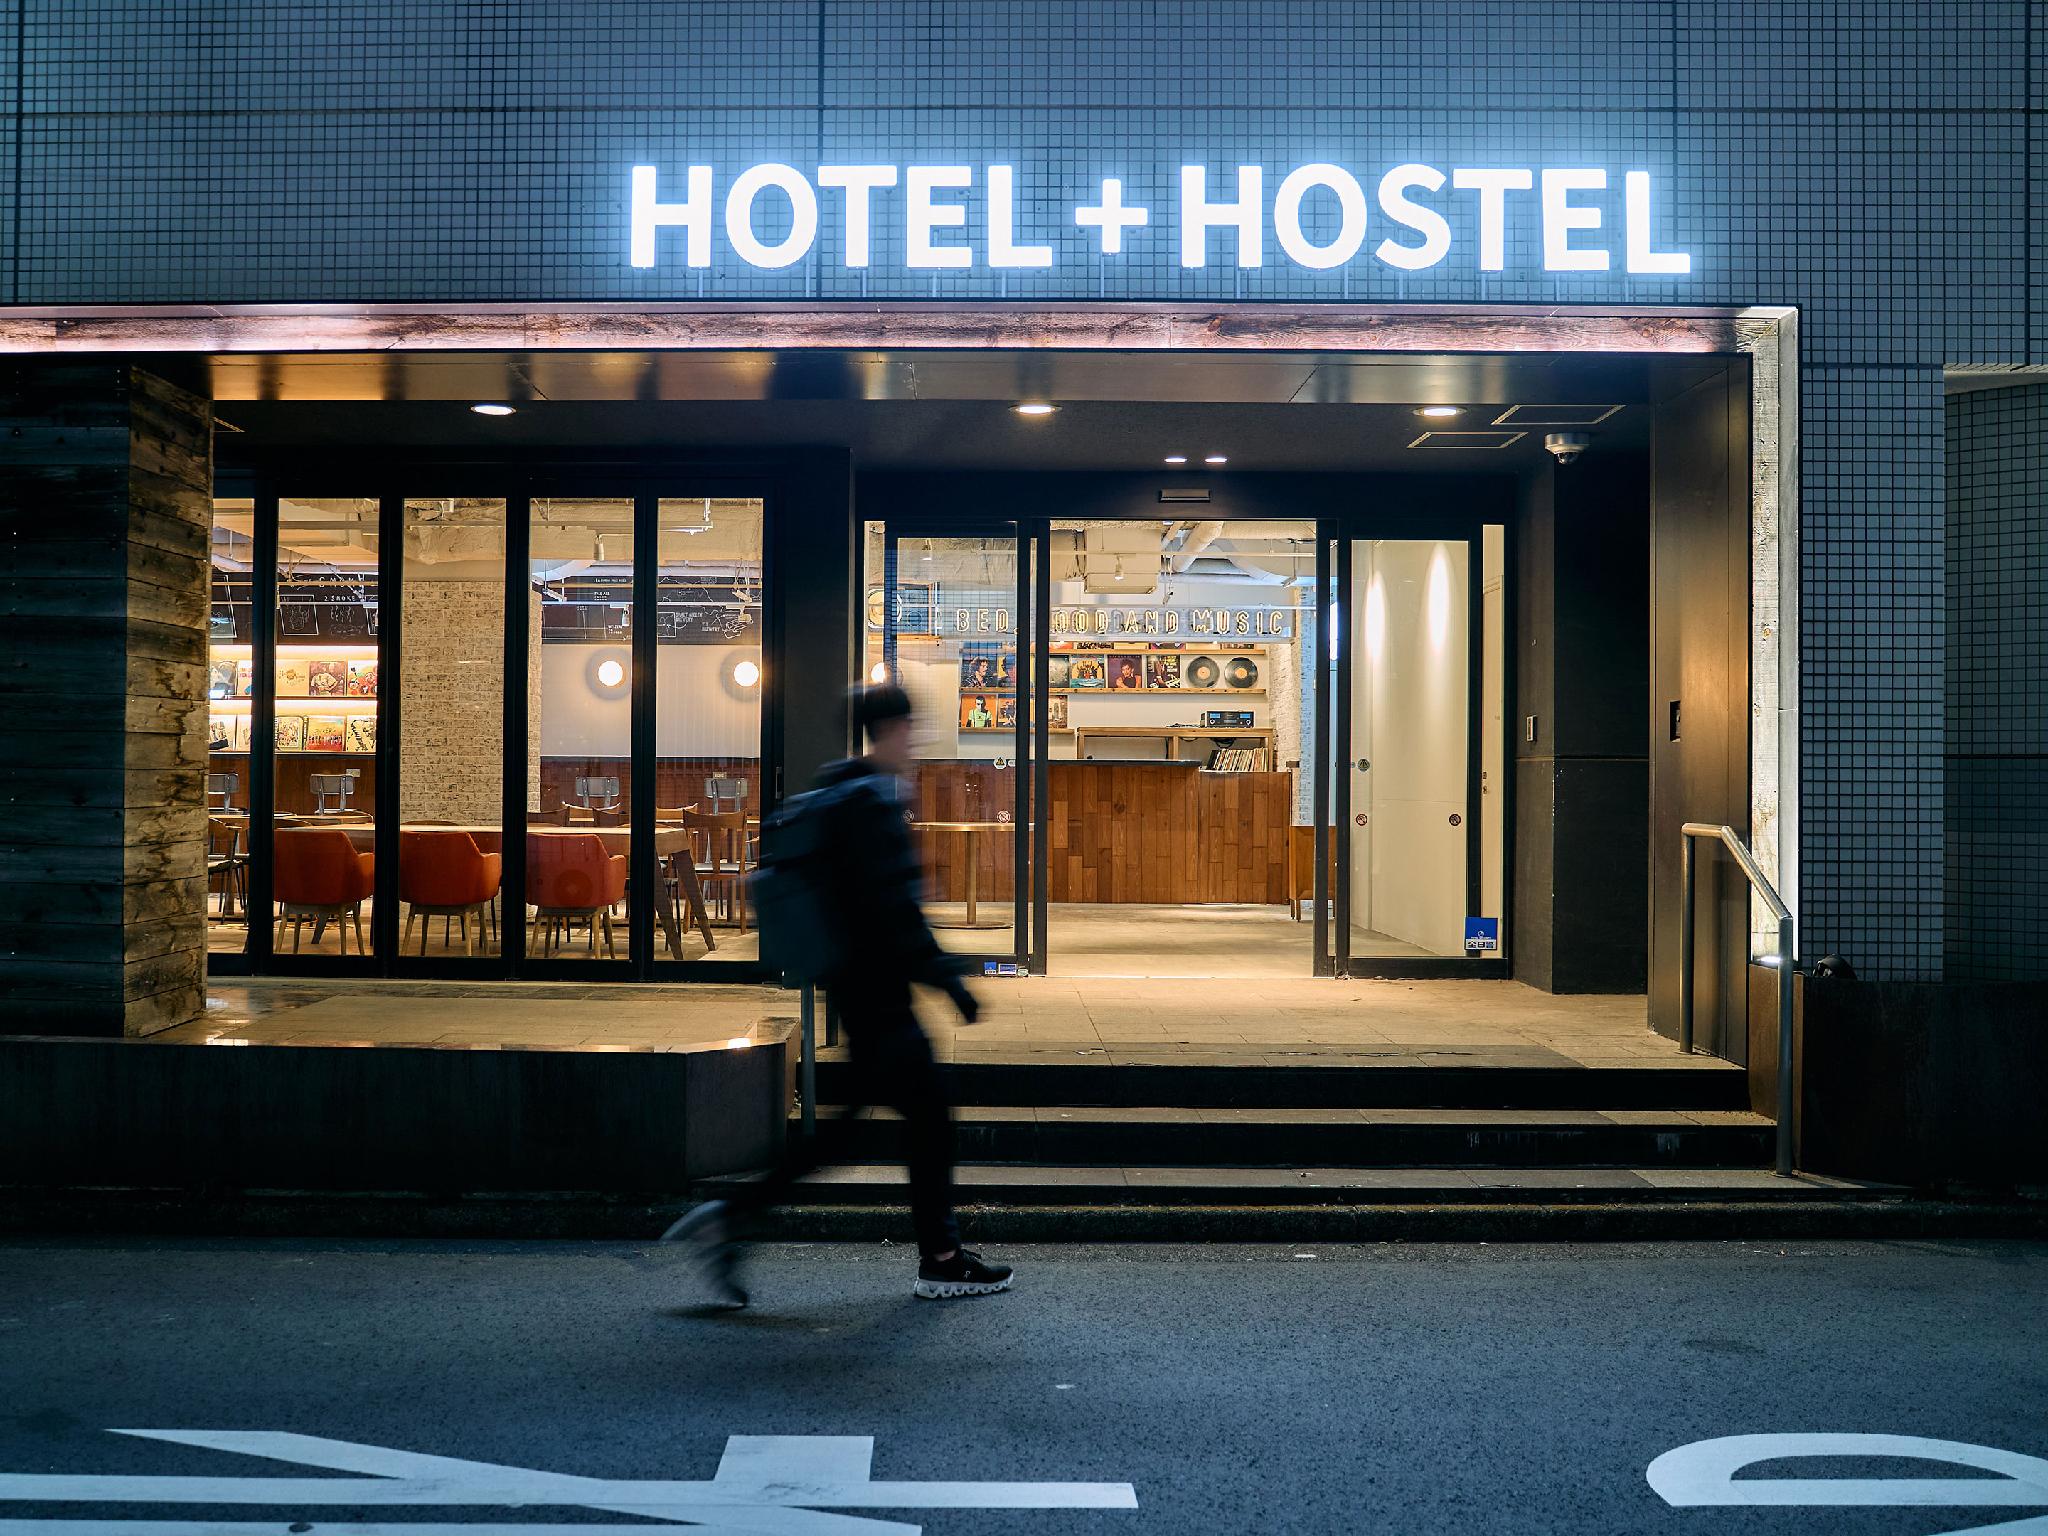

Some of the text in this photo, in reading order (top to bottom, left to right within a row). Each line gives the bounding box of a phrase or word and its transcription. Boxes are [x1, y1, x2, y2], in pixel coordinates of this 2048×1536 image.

[629, 163, 1692, 275] HOTEL + HOSTEL
[1050, 609, 1110, 635] OOD
[1124, 610, 1179, 634] AND
[1192, 609, 1283, 635] MUSIC
